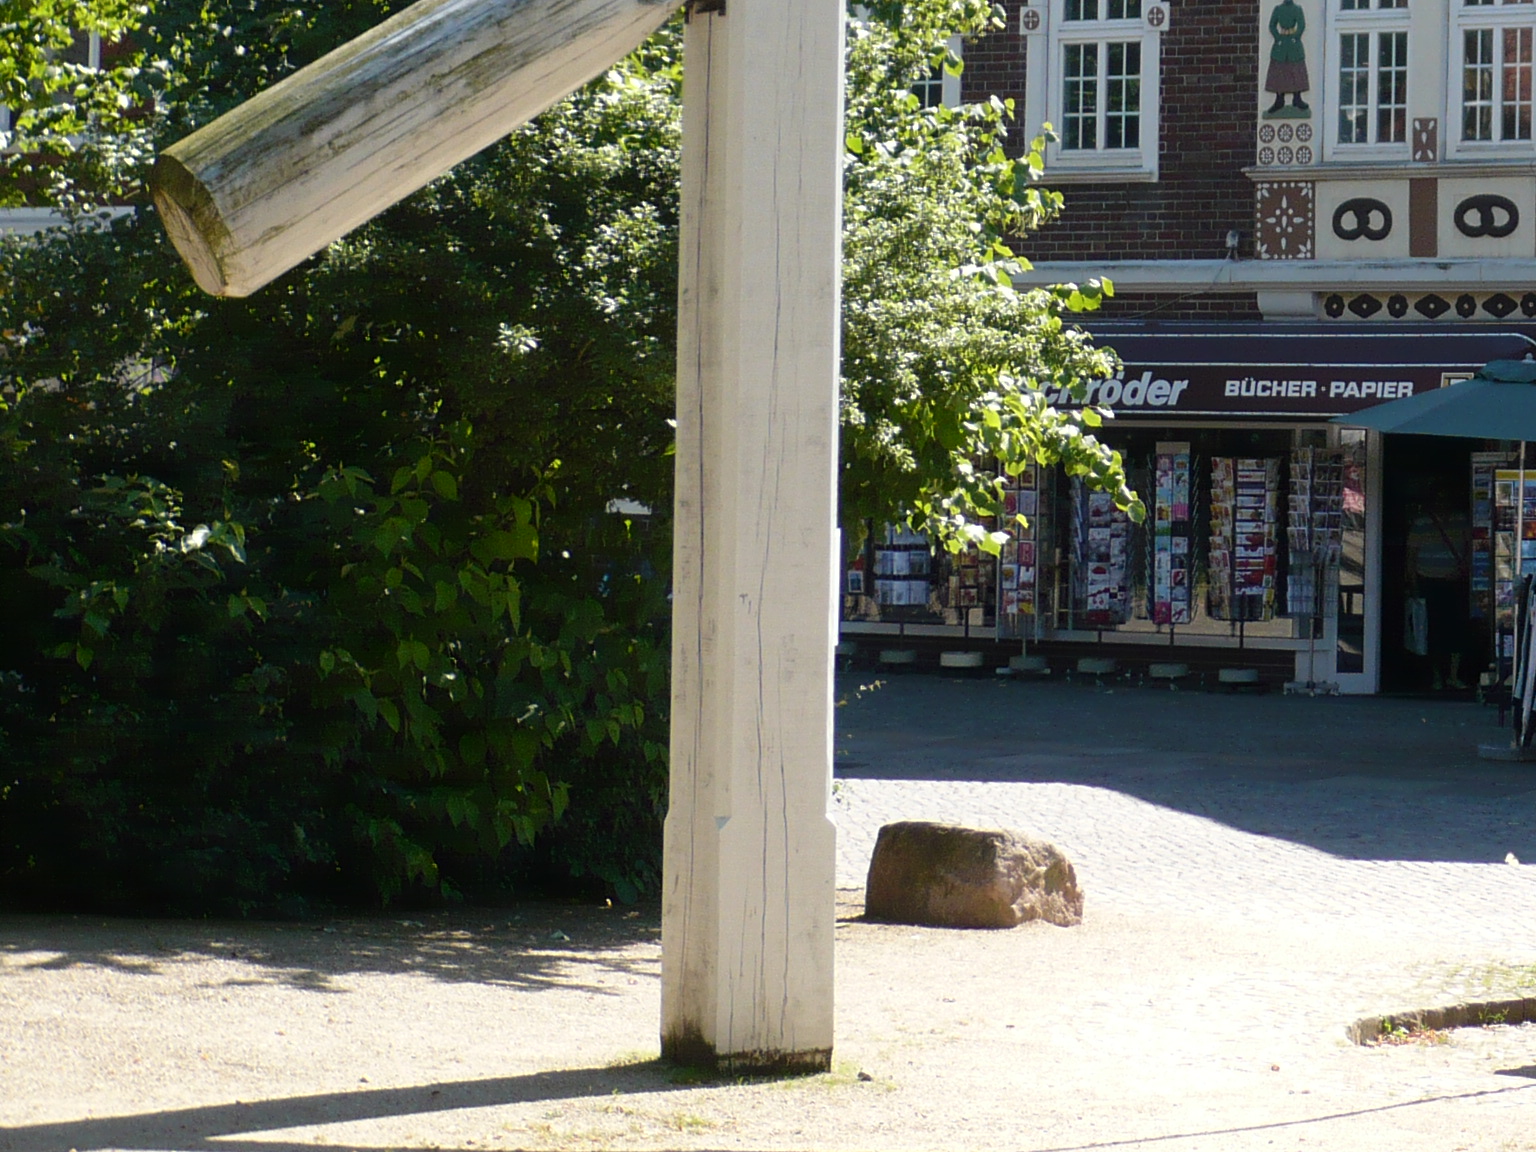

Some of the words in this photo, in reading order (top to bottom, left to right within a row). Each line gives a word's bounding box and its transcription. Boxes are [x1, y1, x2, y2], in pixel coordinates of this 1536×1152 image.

[1018, 370, 1189, 407] cröder
[1224, 377, 1317, 397] BÜCHER
[1329, 380, 1414, 398] PAPIER
